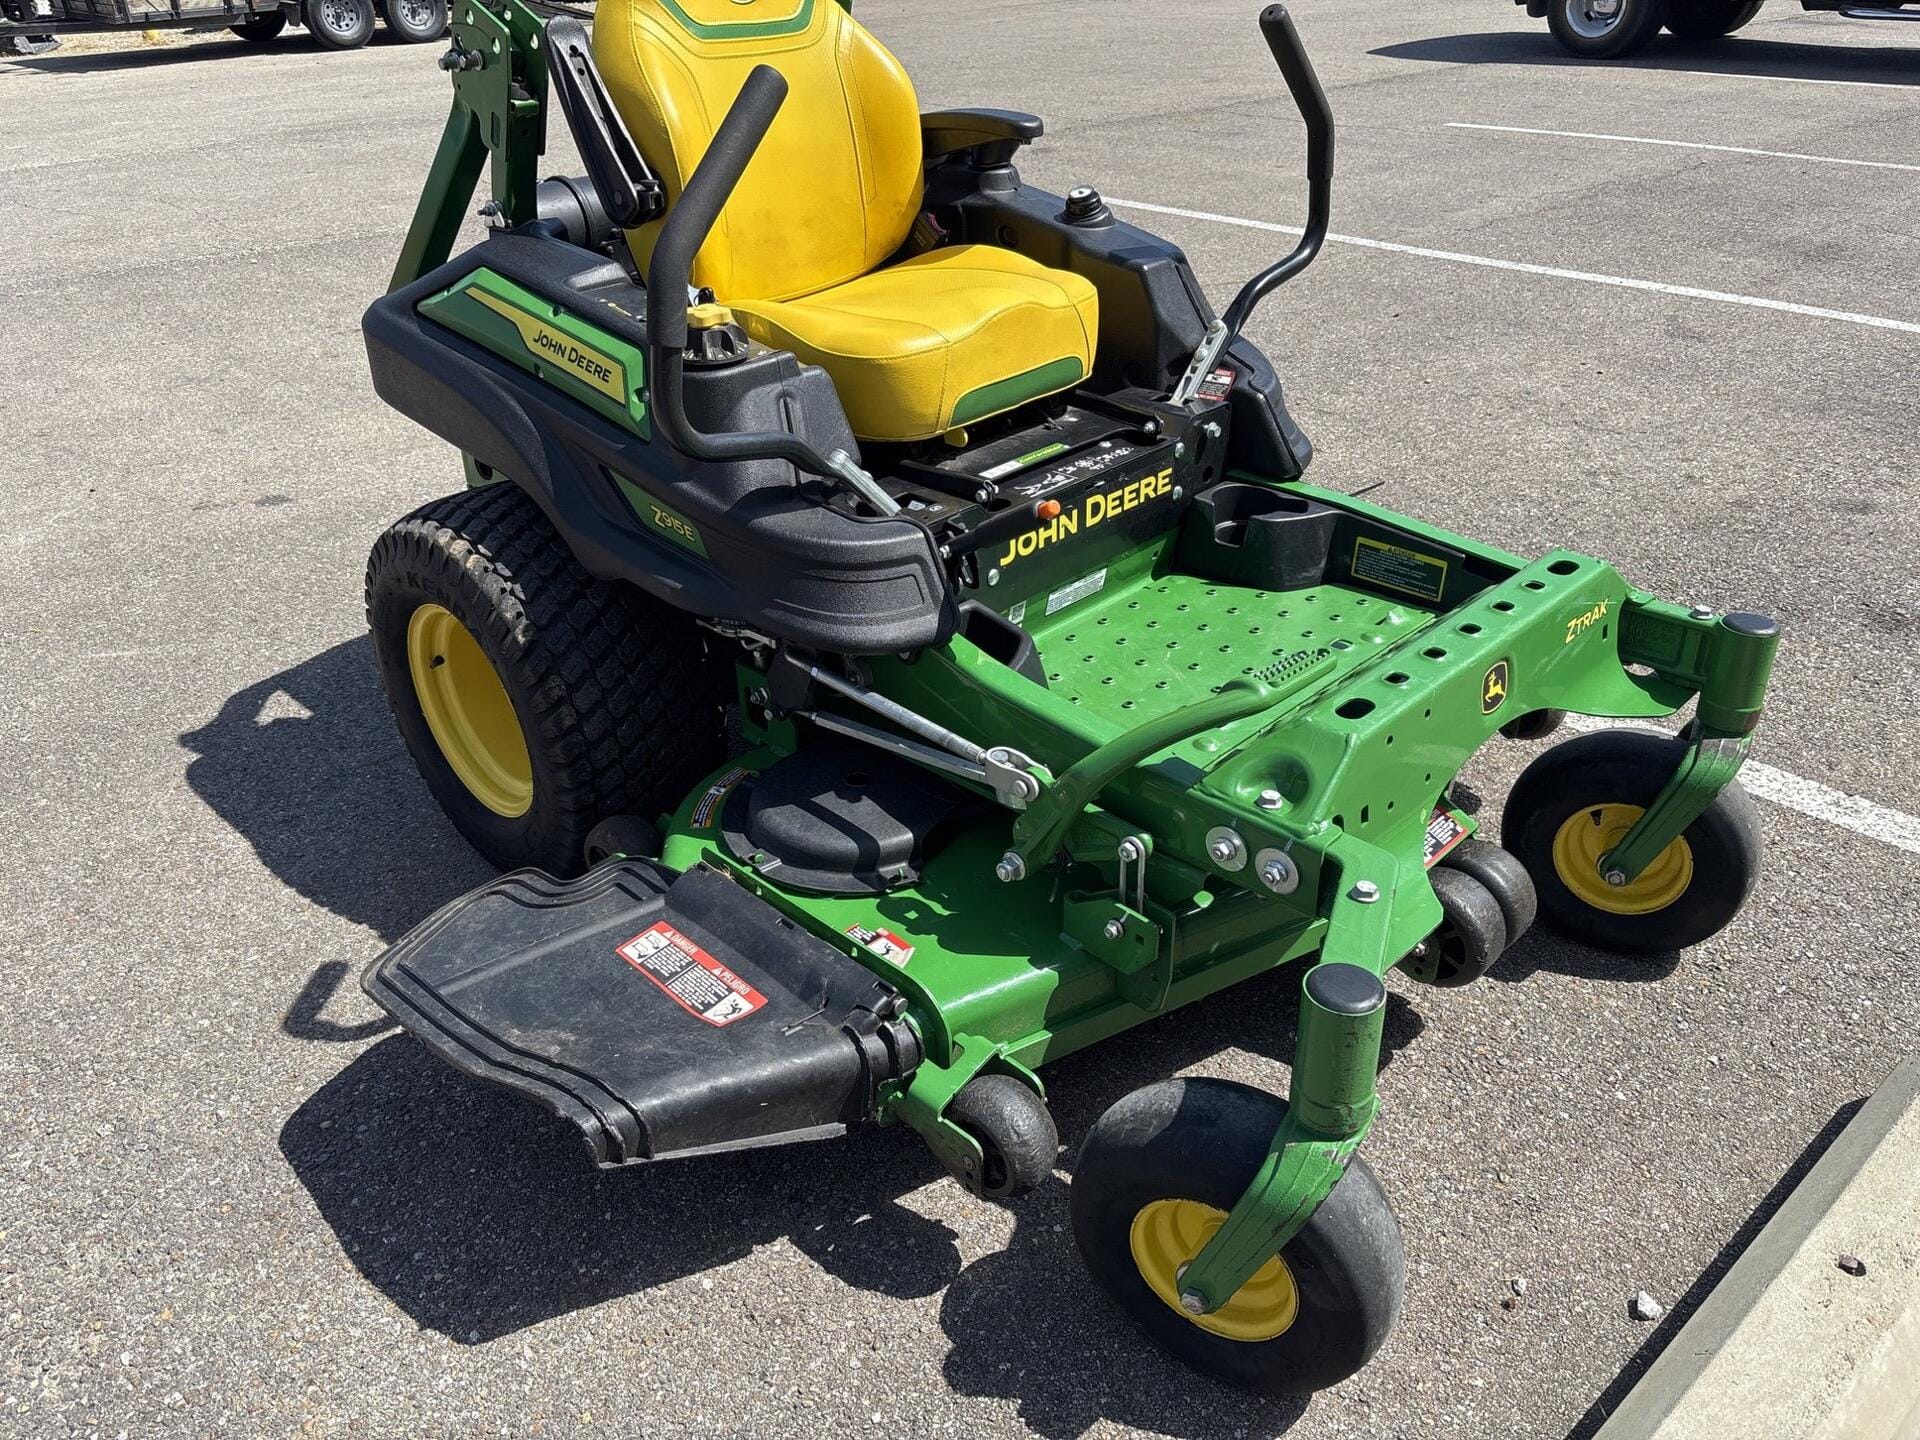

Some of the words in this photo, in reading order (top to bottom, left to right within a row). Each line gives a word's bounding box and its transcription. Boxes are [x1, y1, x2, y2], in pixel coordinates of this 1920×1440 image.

[533, 329, 567, 359] JOHN
[567, 346, 613, 384] DEERE
[650, 505, 696, 542] Z915E
[1000, 508, 1079, 567] JOHN
[1085, 467, 1173, 528] DEERE
[1565, 597, 1609, 644] ZTRAK
[672, 933, 697, 954] DANGER
[719, 971, 750, 995] PELIGRO
